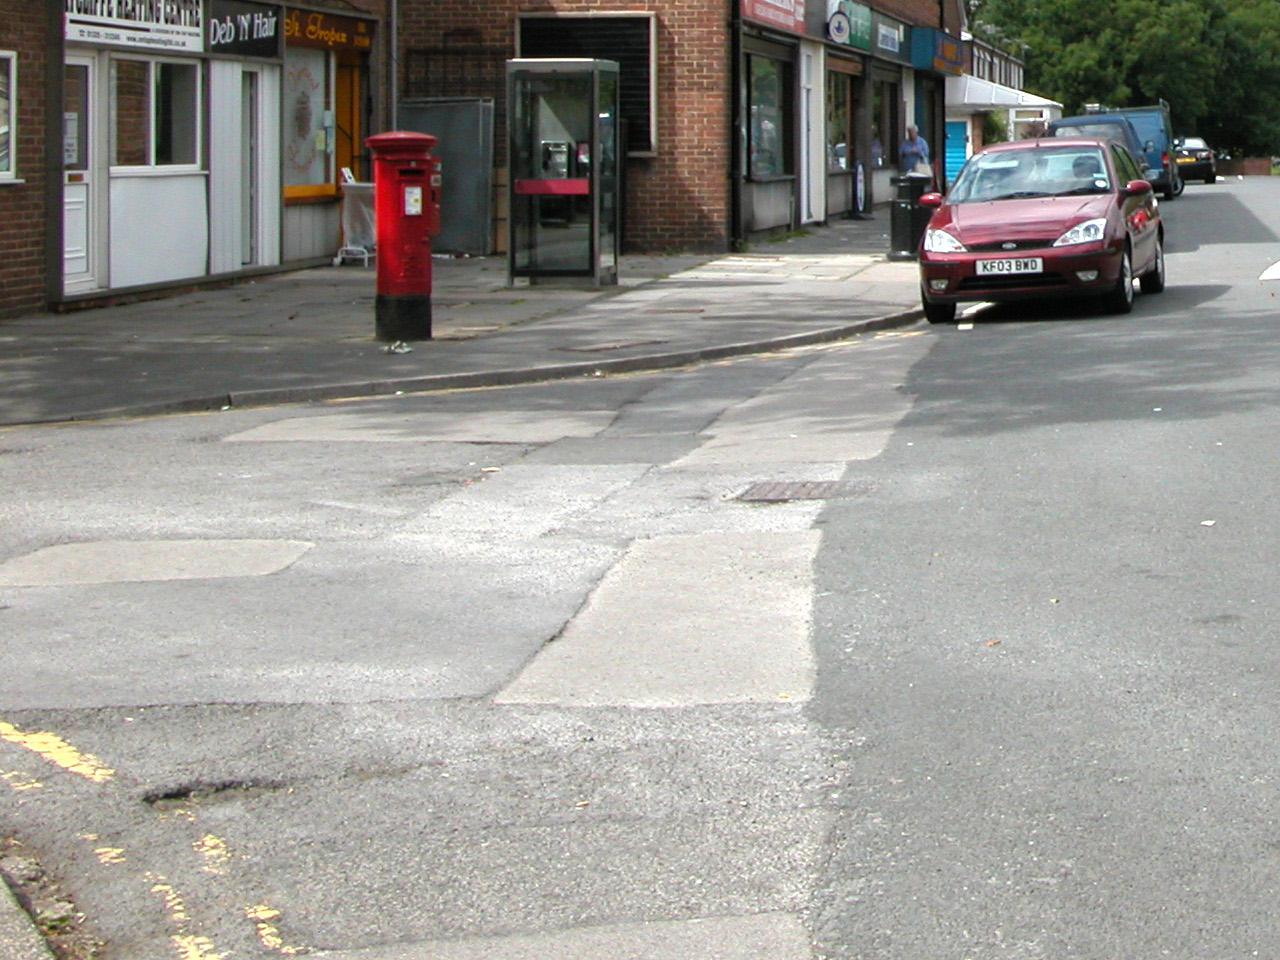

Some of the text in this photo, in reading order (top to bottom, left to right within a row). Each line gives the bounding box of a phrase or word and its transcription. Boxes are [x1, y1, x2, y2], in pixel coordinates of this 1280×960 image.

[211, 11, 277, 45] Deb 'N' Hair
[982, 259, 1037, 273] KF03 BWD
